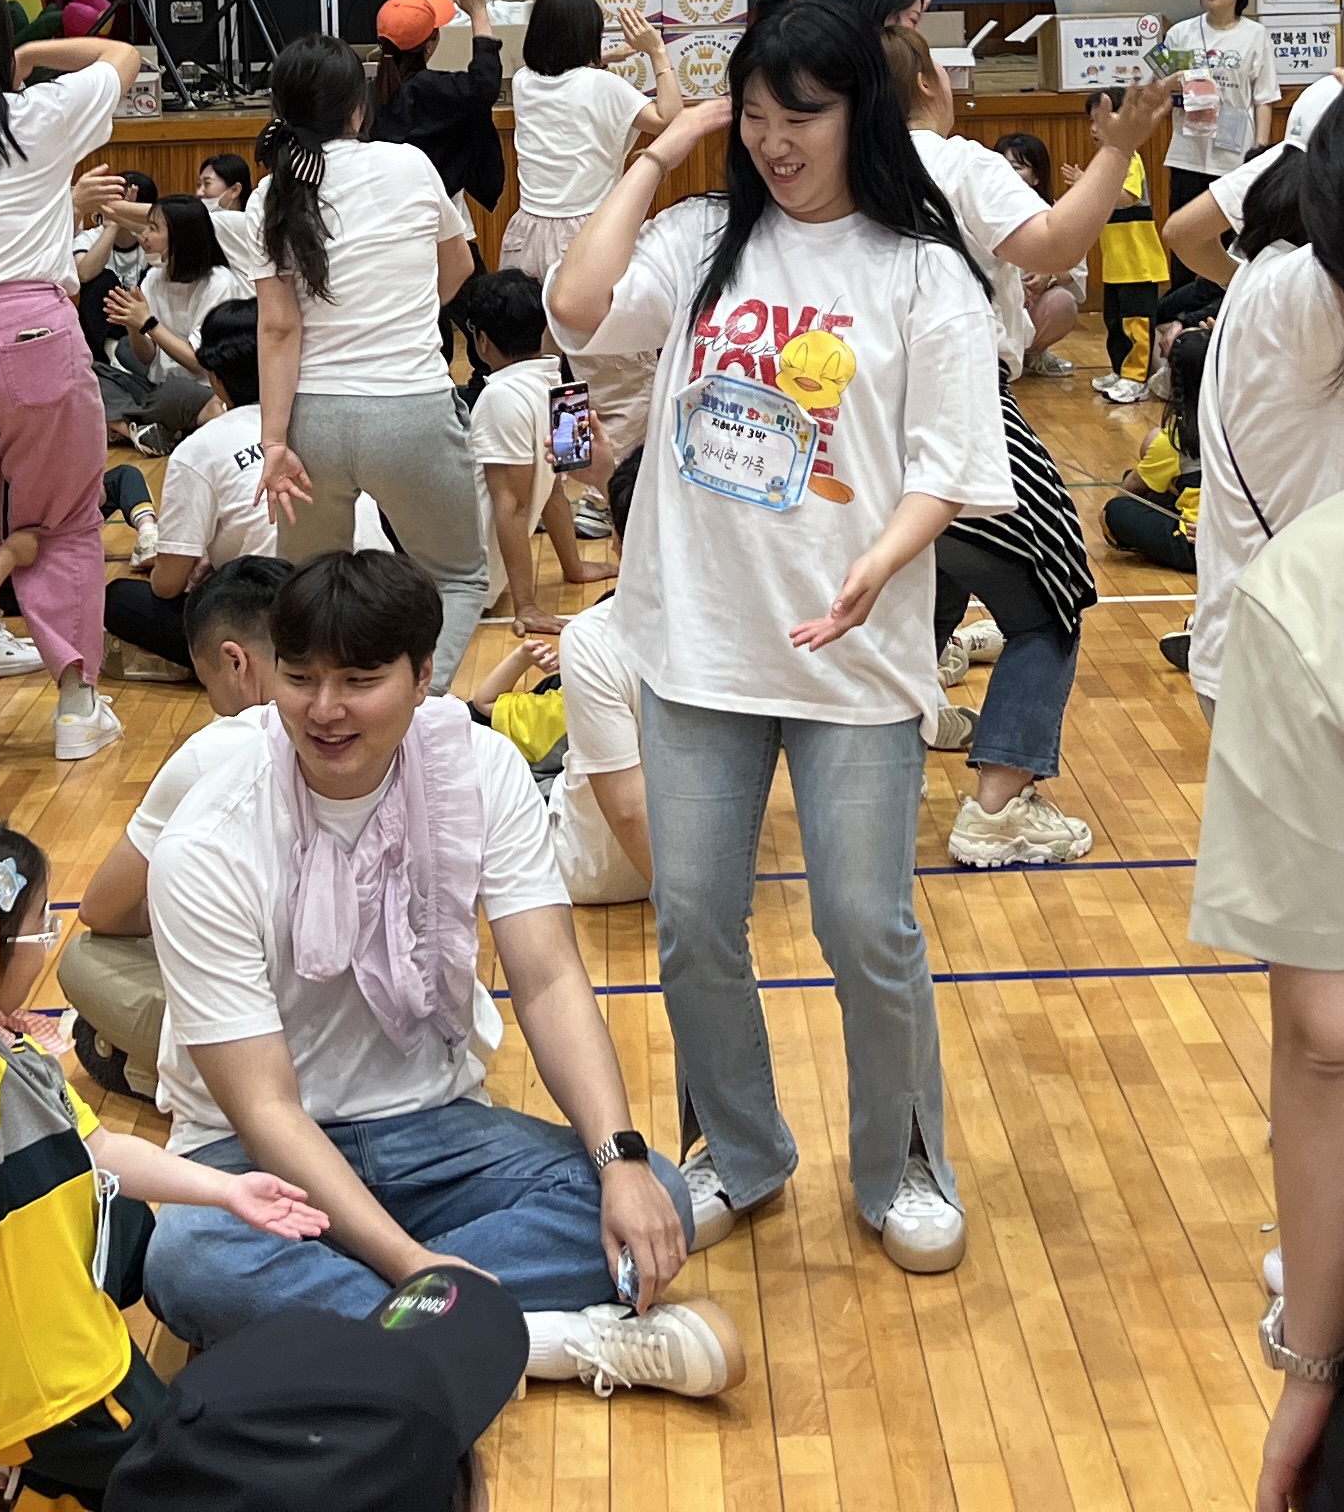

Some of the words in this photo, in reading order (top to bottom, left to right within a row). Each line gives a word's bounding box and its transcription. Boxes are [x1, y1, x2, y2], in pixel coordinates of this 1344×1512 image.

[1139, 19, 1158, 34] 80
[1270, 32, 1307, 45] 행복샘
[1312, 32, 1331, 45] 1반
[689, 62, 724, 76] MVP
[711, 417, 745, 437] 지혜샘
[746, 428, 767, 443] 3반
[741, 455, 765, 477] 가족
